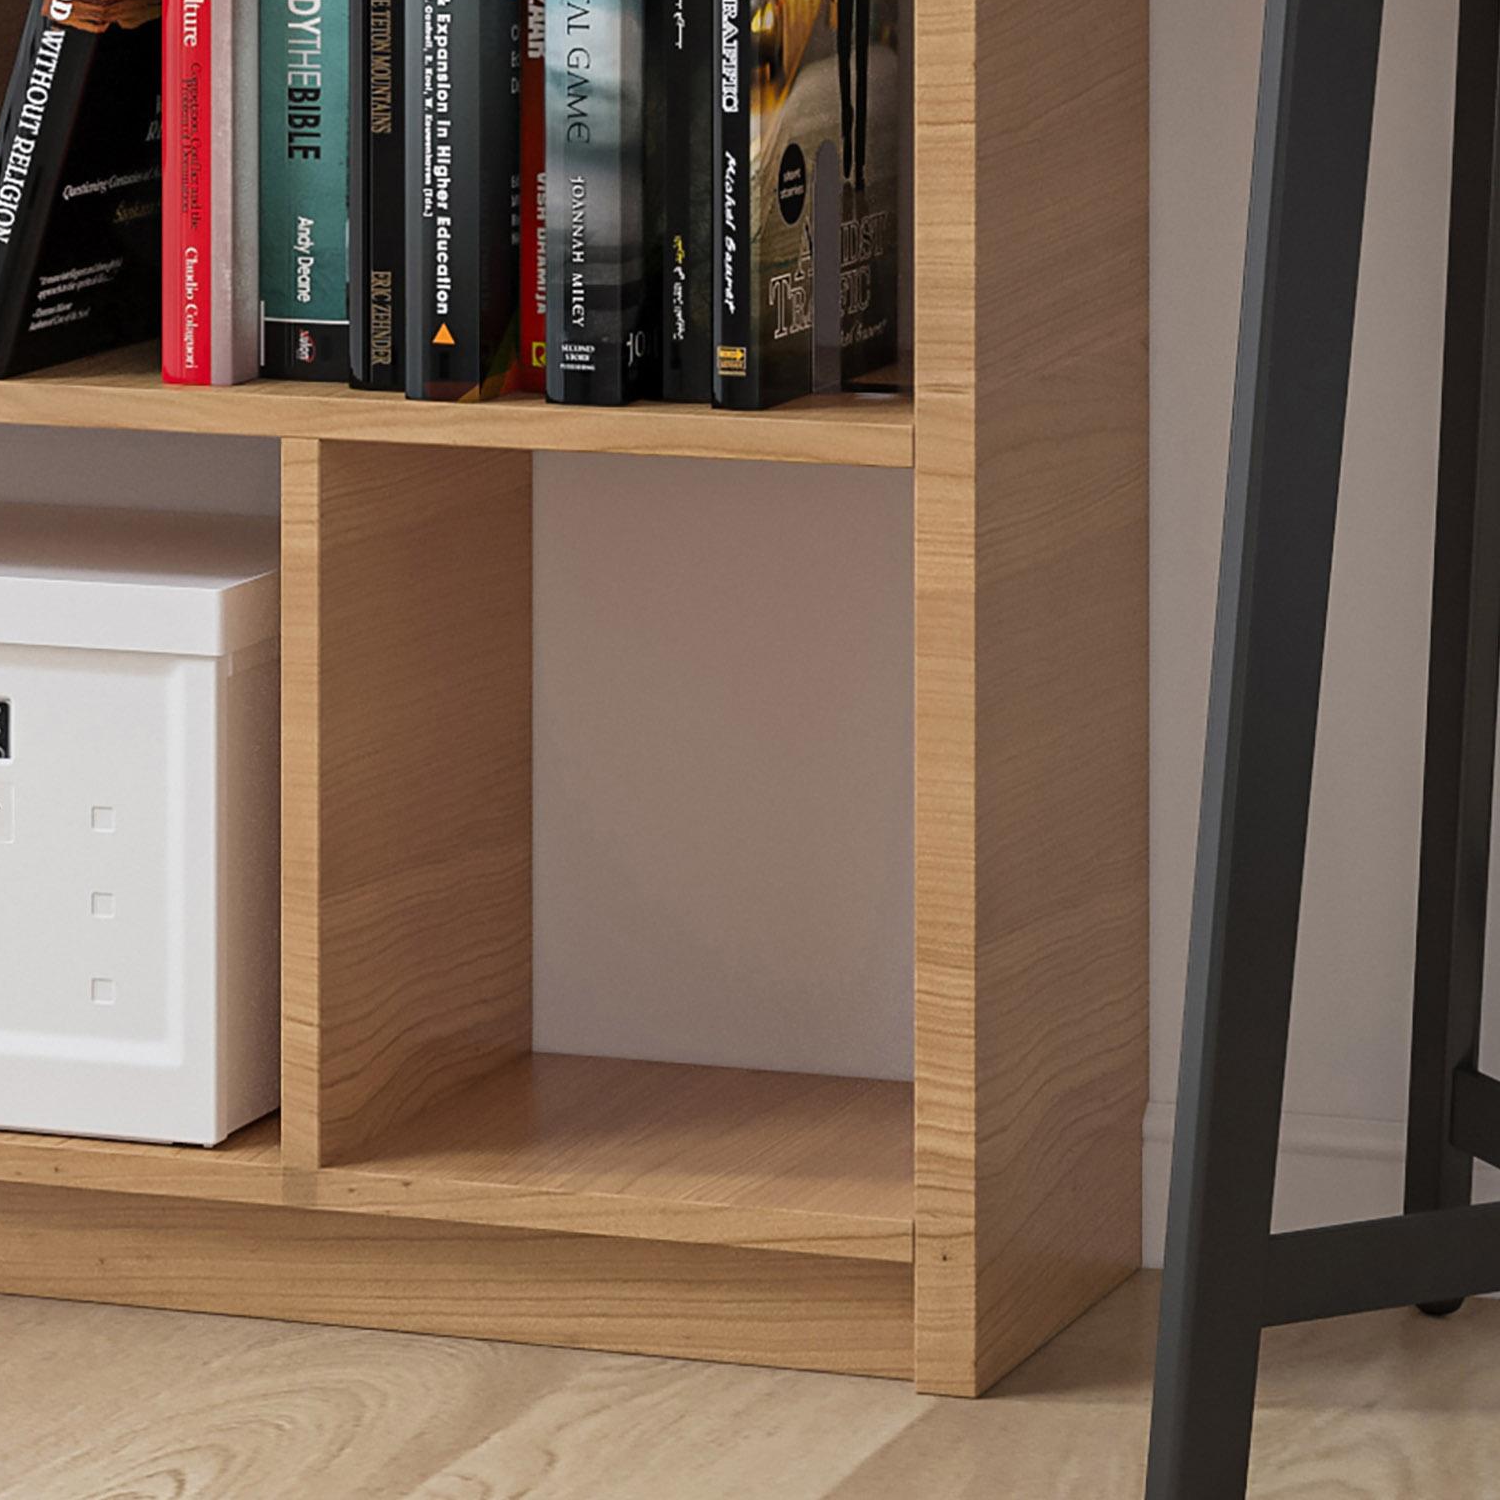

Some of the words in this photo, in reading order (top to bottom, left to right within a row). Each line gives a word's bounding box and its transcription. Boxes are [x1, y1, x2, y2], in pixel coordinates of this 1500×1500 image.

[371, 10, 392, 53] TETON
[18, 29, 66, 136] WITHOUT
[371, 54, 392, 134] MOUNTAINS
[433, 14, 451, 113] Expansion
[566, 47, 591, 144] GAME
[433, 144, 451, 210] Higher
[293, 216, 315, 254] Andy
[569, 175, 585, 263] JOANNAH
[185, 247, 199, 300] Claudio
[296, 257, 315, 303] Deane
[371, 271, 392, 301] ERIC
[436, 216, 451, 315] Education
[571, 272, 585, 328] MILEY
[371, 304, 392, 365] ZEHNDER
